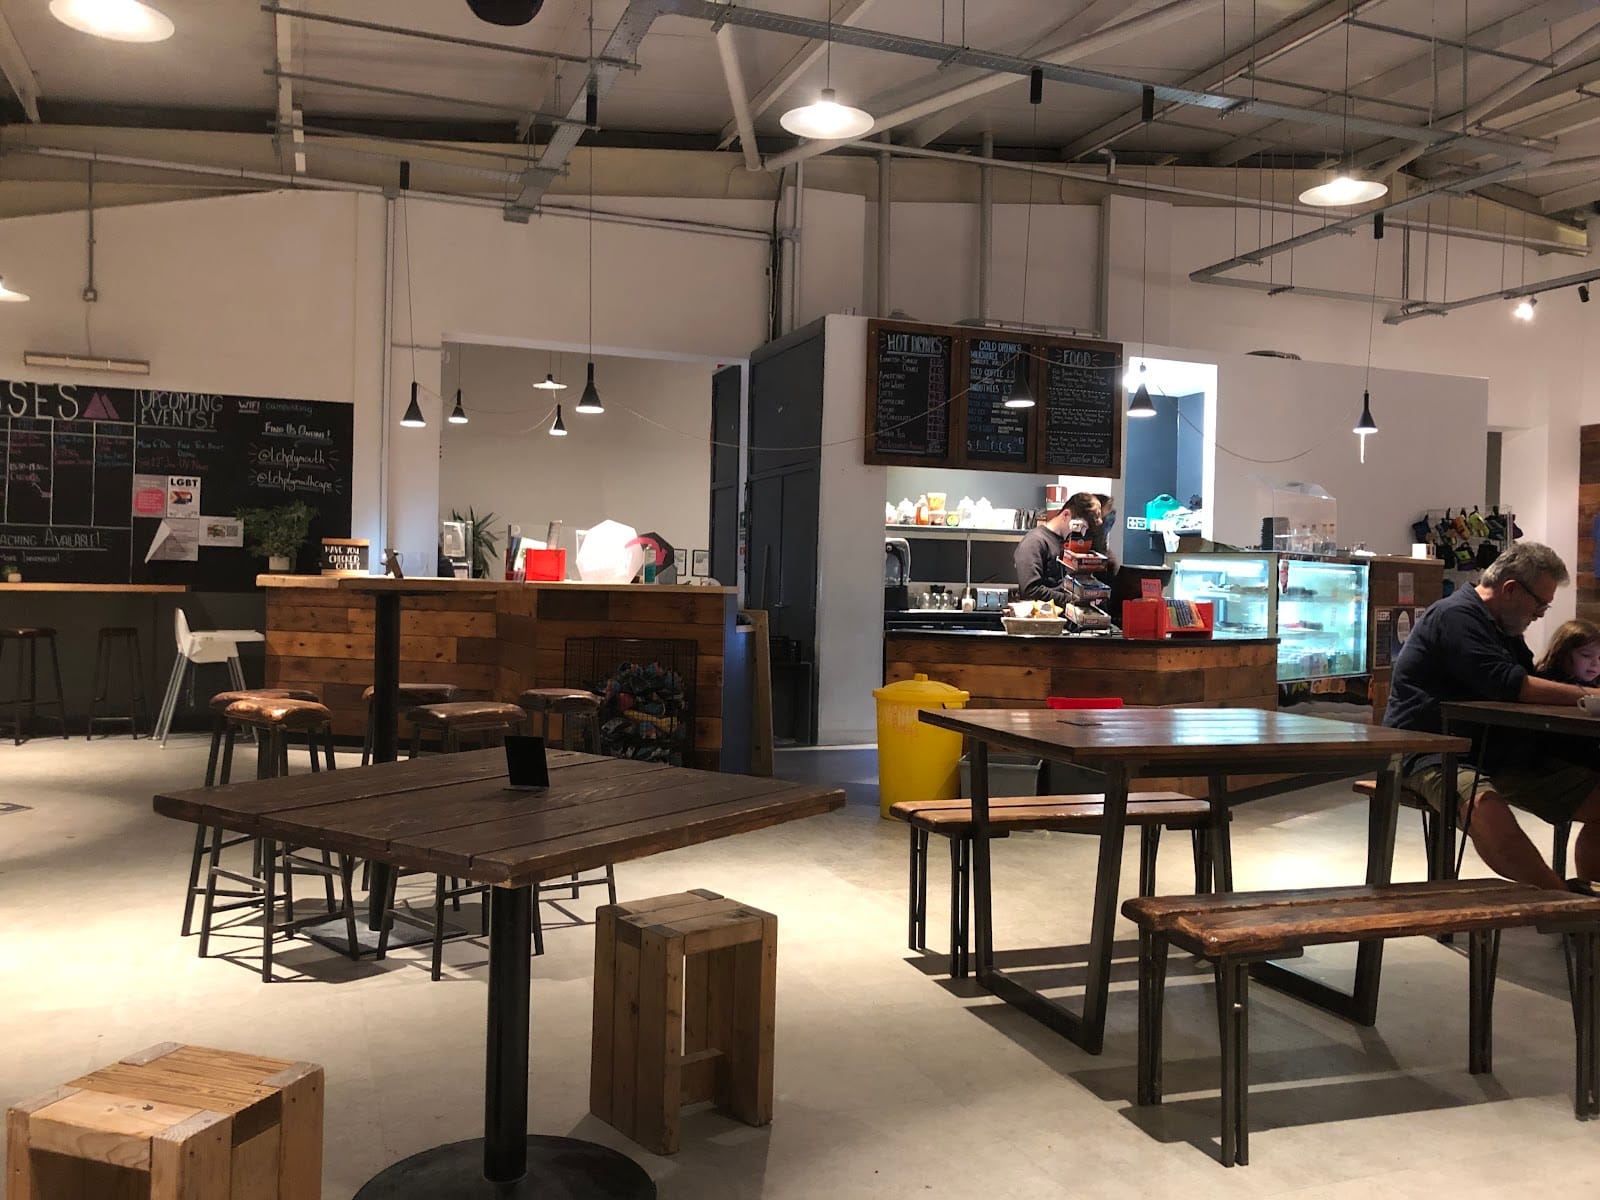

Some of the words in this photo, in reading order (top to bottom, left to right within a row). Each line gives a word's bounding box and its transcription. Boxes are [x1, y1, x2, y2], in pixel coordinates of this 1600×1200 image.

[887, 334, 910, 352] HOT
[911, 335, 943, 355] DRINKS
[979, 340, 997, 352] COLD
[997, 343, 1022, 354] DRINKS
[1063, 350, 1091, 367] FOOD
[0, 381, 79, 420] SES
[139, 390, 224, 413] UPCOMING
[141, 408, 215, 429] EVENTS!
[170, 477, 199, 488] LGBT
[346, 547, 360, 555] YOU
